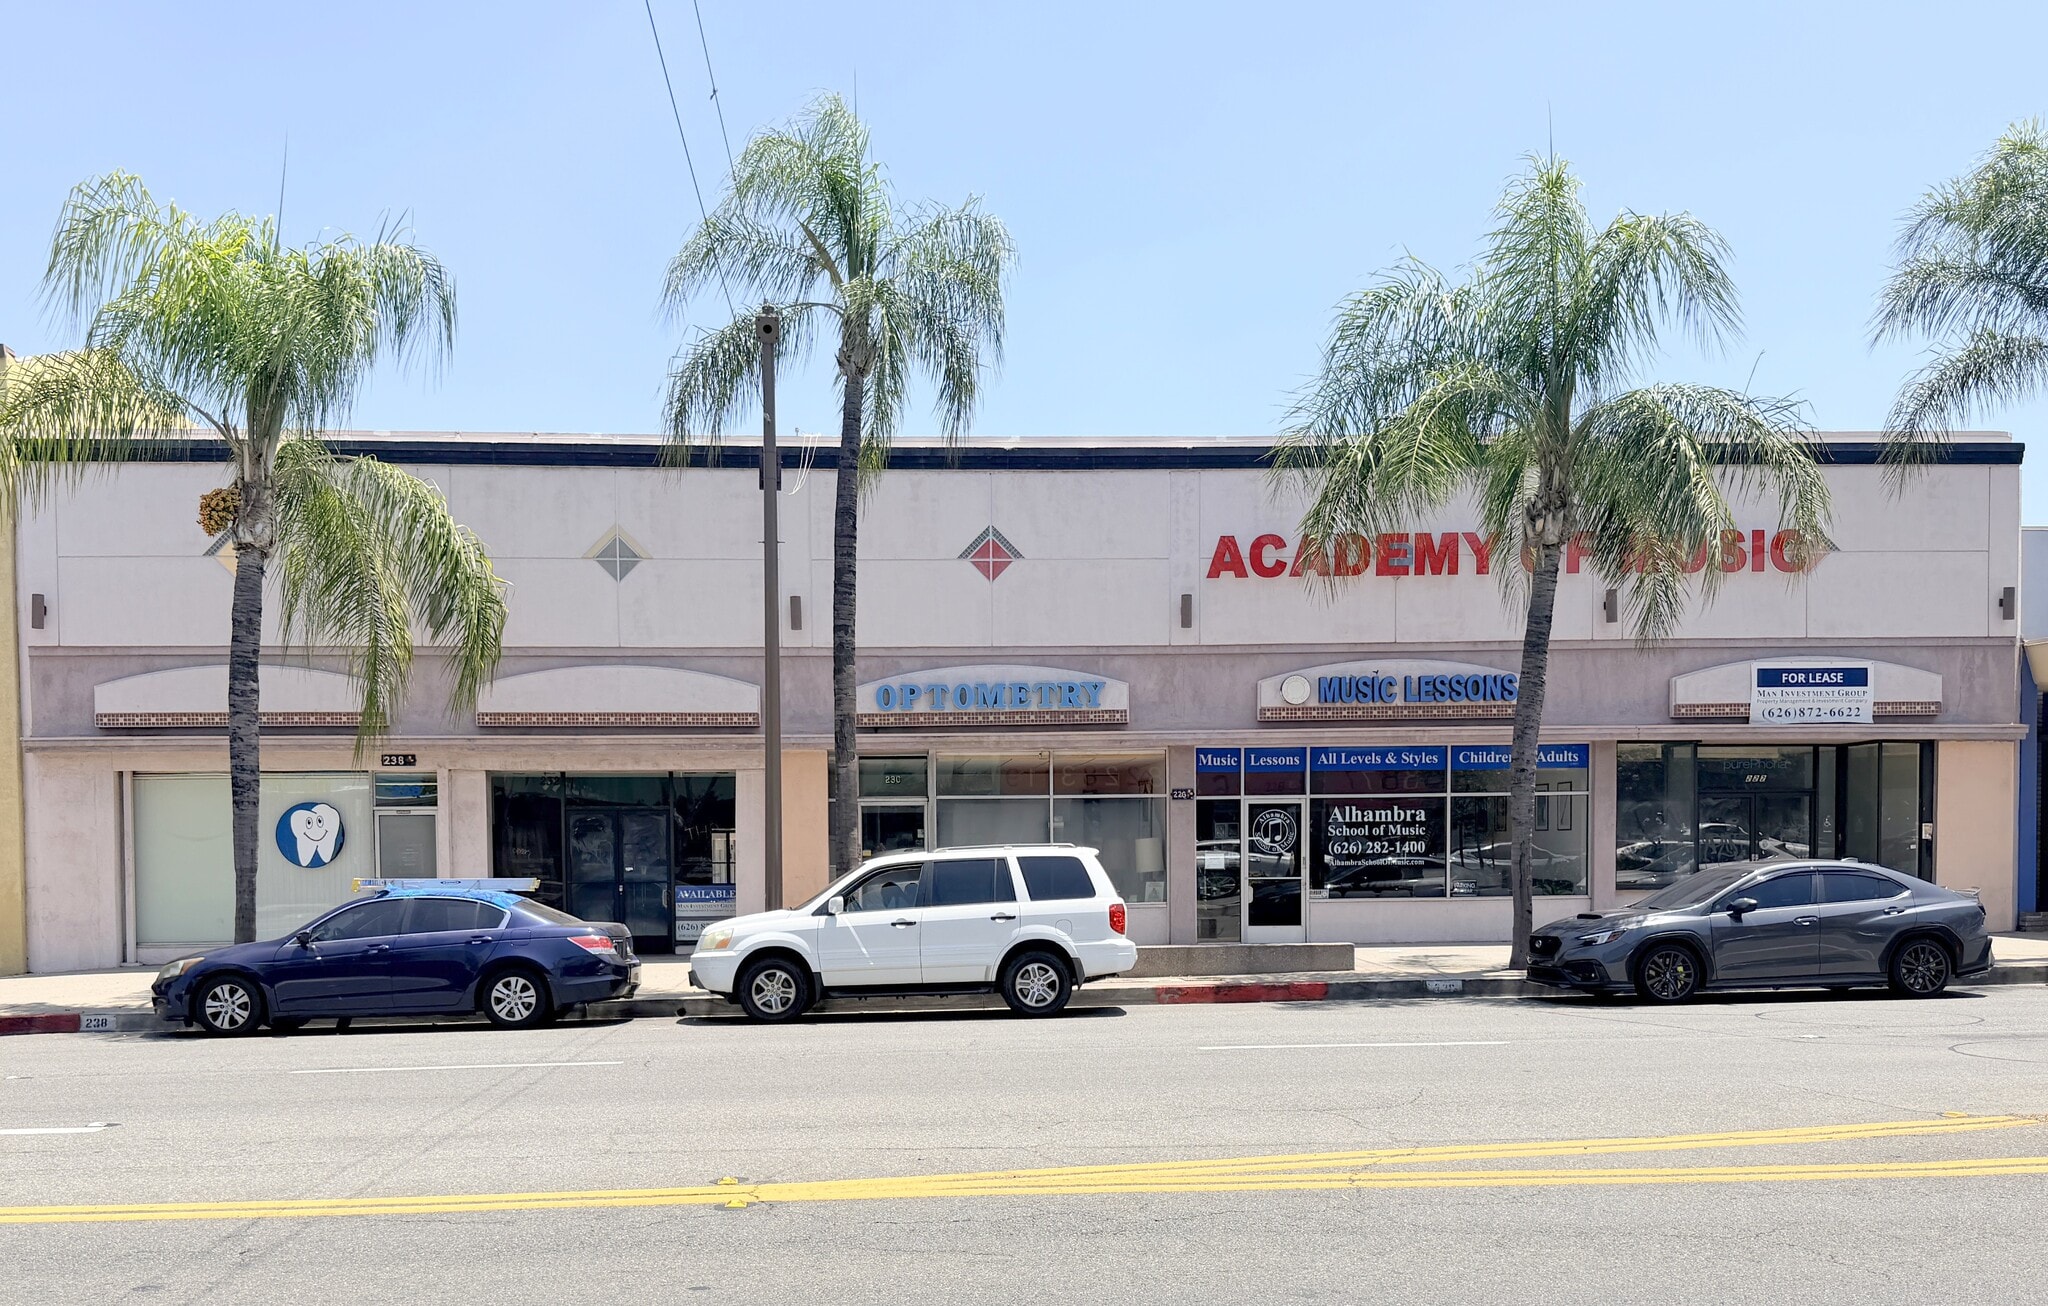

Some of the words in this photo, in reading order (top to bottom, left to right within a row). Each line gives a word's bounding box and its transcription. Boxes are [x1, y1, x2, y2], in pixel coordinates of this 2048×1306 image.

[1206, 531, 1498, 579] ACADEMY
[1781, 672, 1806, 684] FOR
[1808, 672, 1844, 683] LEASE
[1318, 675, 1398, 704] MUSIC
[1404, 673, 1519, 703] LESSONS
[875, 681, 1107, 711] OPTOMETRY
[1762, 707, 1861, 719] (626)872-6622
[383, 755, 405, 765] 238
[1199, 754, 1238, 766] Music
[1250, 754, 1300, 766] Lessons
[1317, 753, 1337, 764] All
[1340, 752, 1382, 764] Levels
[1385, 752, 1397, 764] &
[1401, 752, 1439, 766] Styles
[1536, 750, 1579, 762] Adults
[885, 775, 901, 784] 230
[1328, 806, 1426, 822] Alhambra
[1328, 824, 1369, 837] School
[1372, 824, 1386, 836] of
[1388, 824, 1426, 836] Music
[1328, 841, 1362, 855] (626)
[1365, 840, 1426, 854] 282-1400
[677, 890, 736, 898] AVAILABLE
[678, 923, 699, 931] (626)
[85, 1018, 108, 1028] 238
